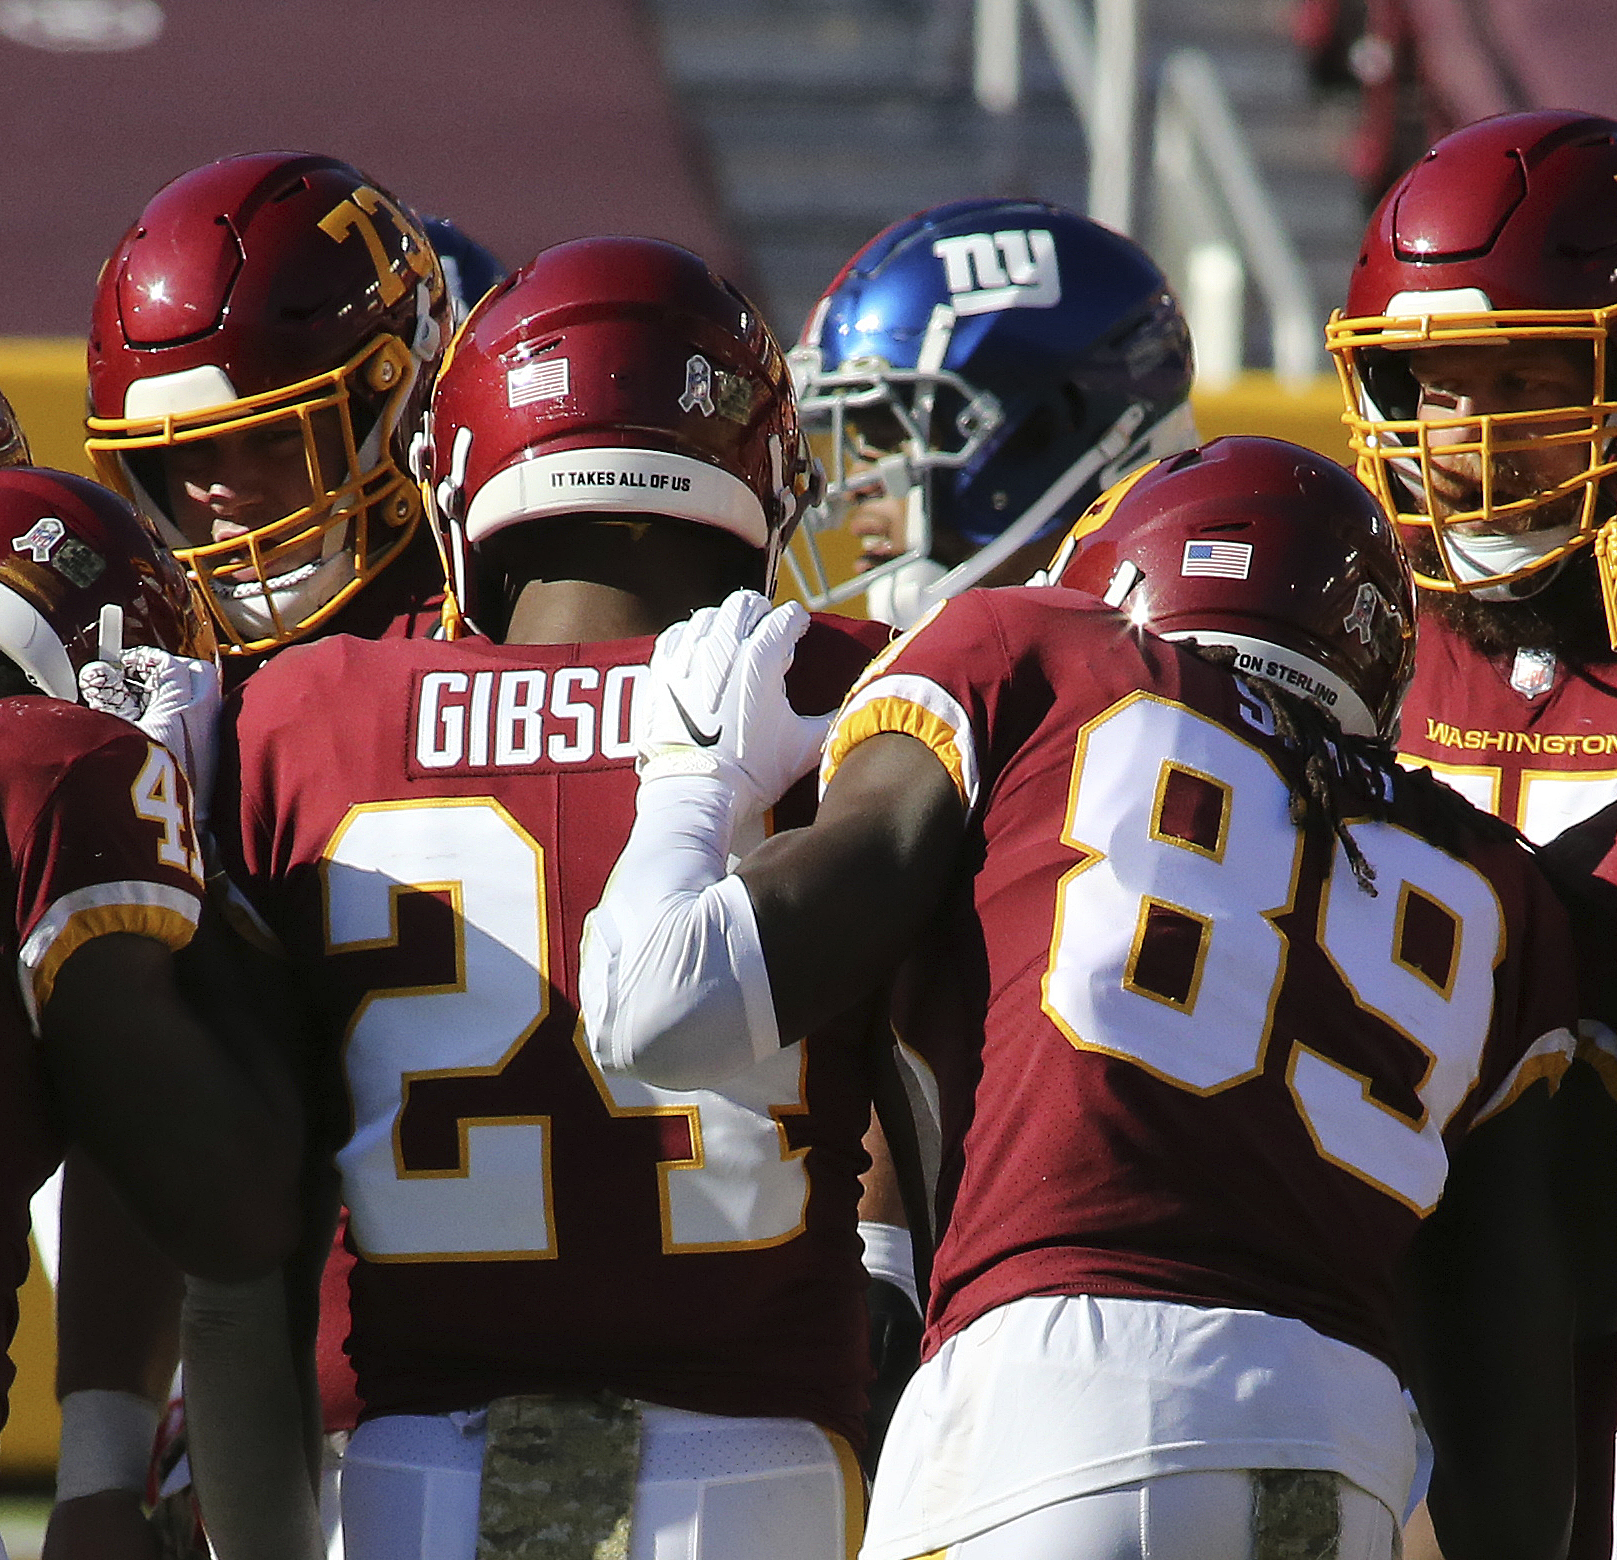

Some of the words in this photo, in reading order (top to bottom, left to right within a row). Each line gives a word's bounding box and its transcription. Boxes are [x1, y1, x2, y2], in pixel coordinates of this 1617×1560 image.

[552, 472, 564, 487] IT
[568, 471, 615, 487] TAKES
[619, 472, 647, 488] ALL
[650, 473, 669, 490] OF
[671, 476, 691, 492] US
[415, 664, 652, 769] GIBSO
[1266, 662, 1339, 707] STERLING
[1040, 688, 1507, 1220] 89
[322, 795, 810, 1265] 24
